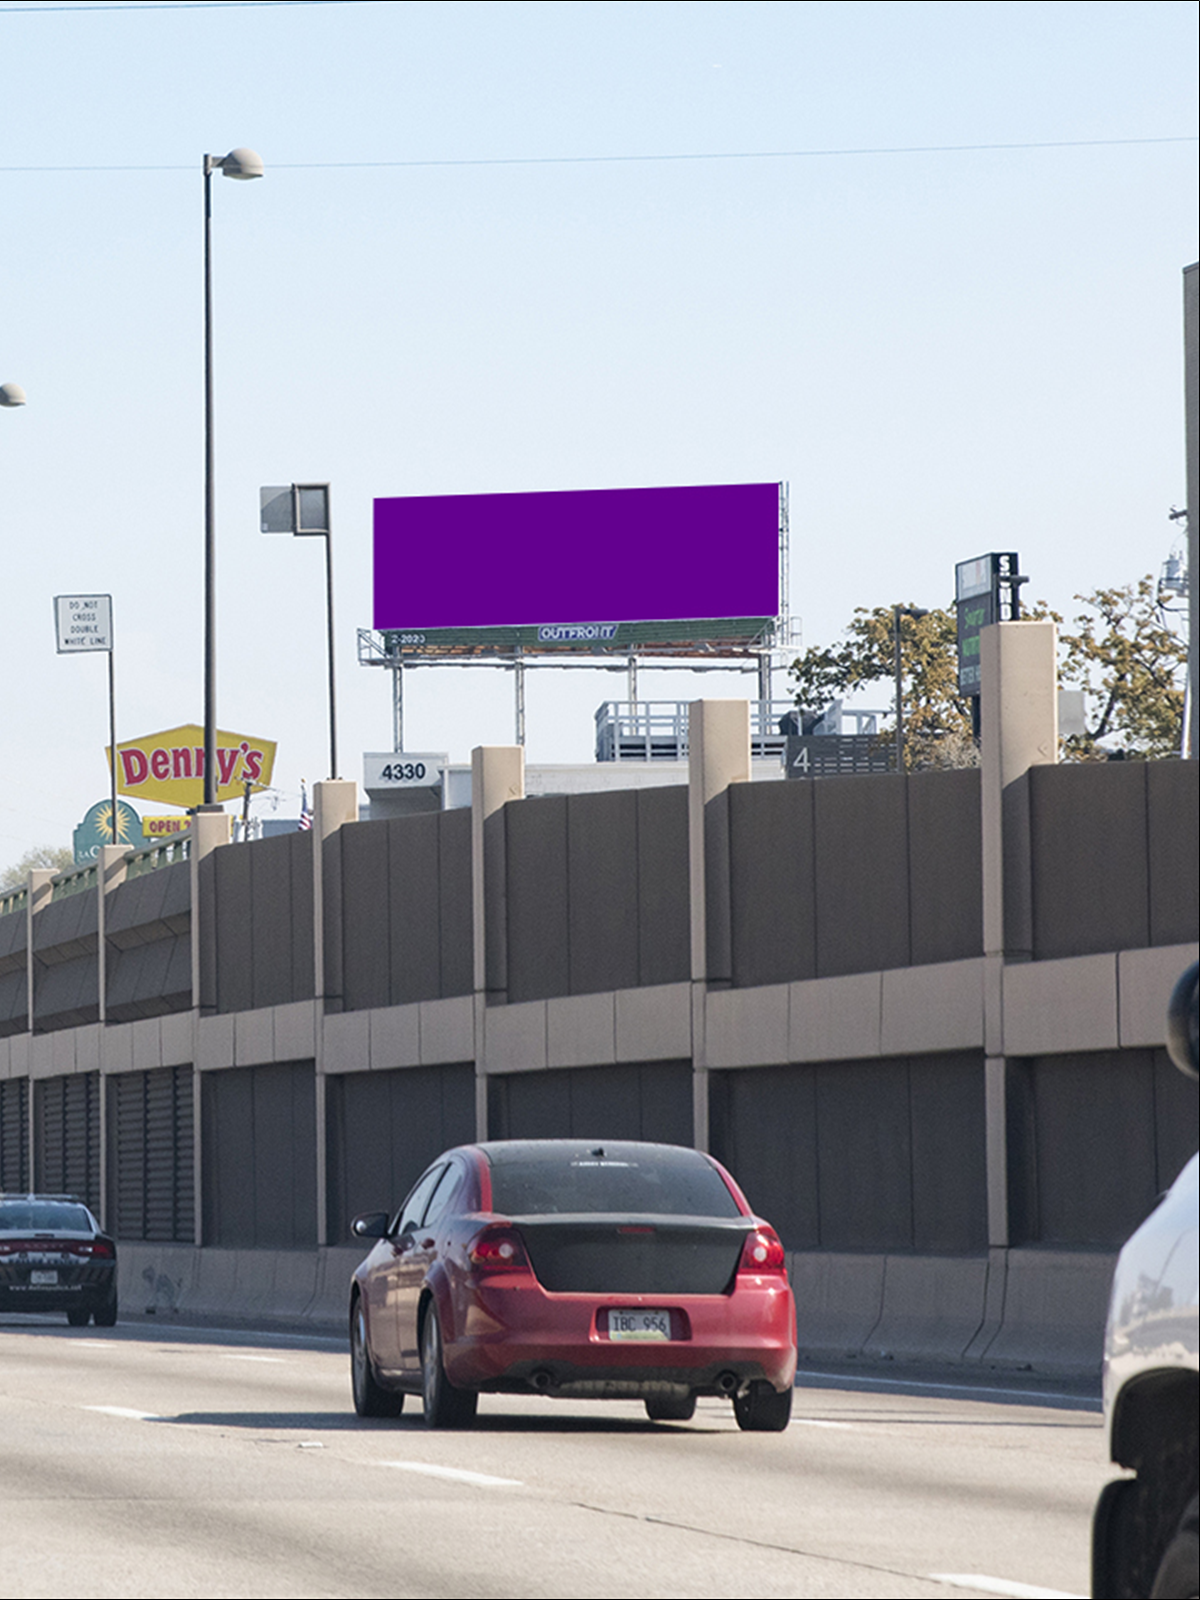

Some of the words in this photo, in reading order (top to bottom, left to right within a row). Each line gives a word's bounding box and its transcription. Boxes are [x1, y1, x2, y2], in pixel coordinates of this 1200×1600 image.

[72, 613, 96, 621] CROSS
[70, 625, 98, 633] DOUBLE
[89, 637, 106, 645] LINE
[793, 747, 811, 773] 4
[382, 762, 426, 780] 4330
[149, 820, 180, 833] OPEN
[643, 1316, 667, 1332] 956
